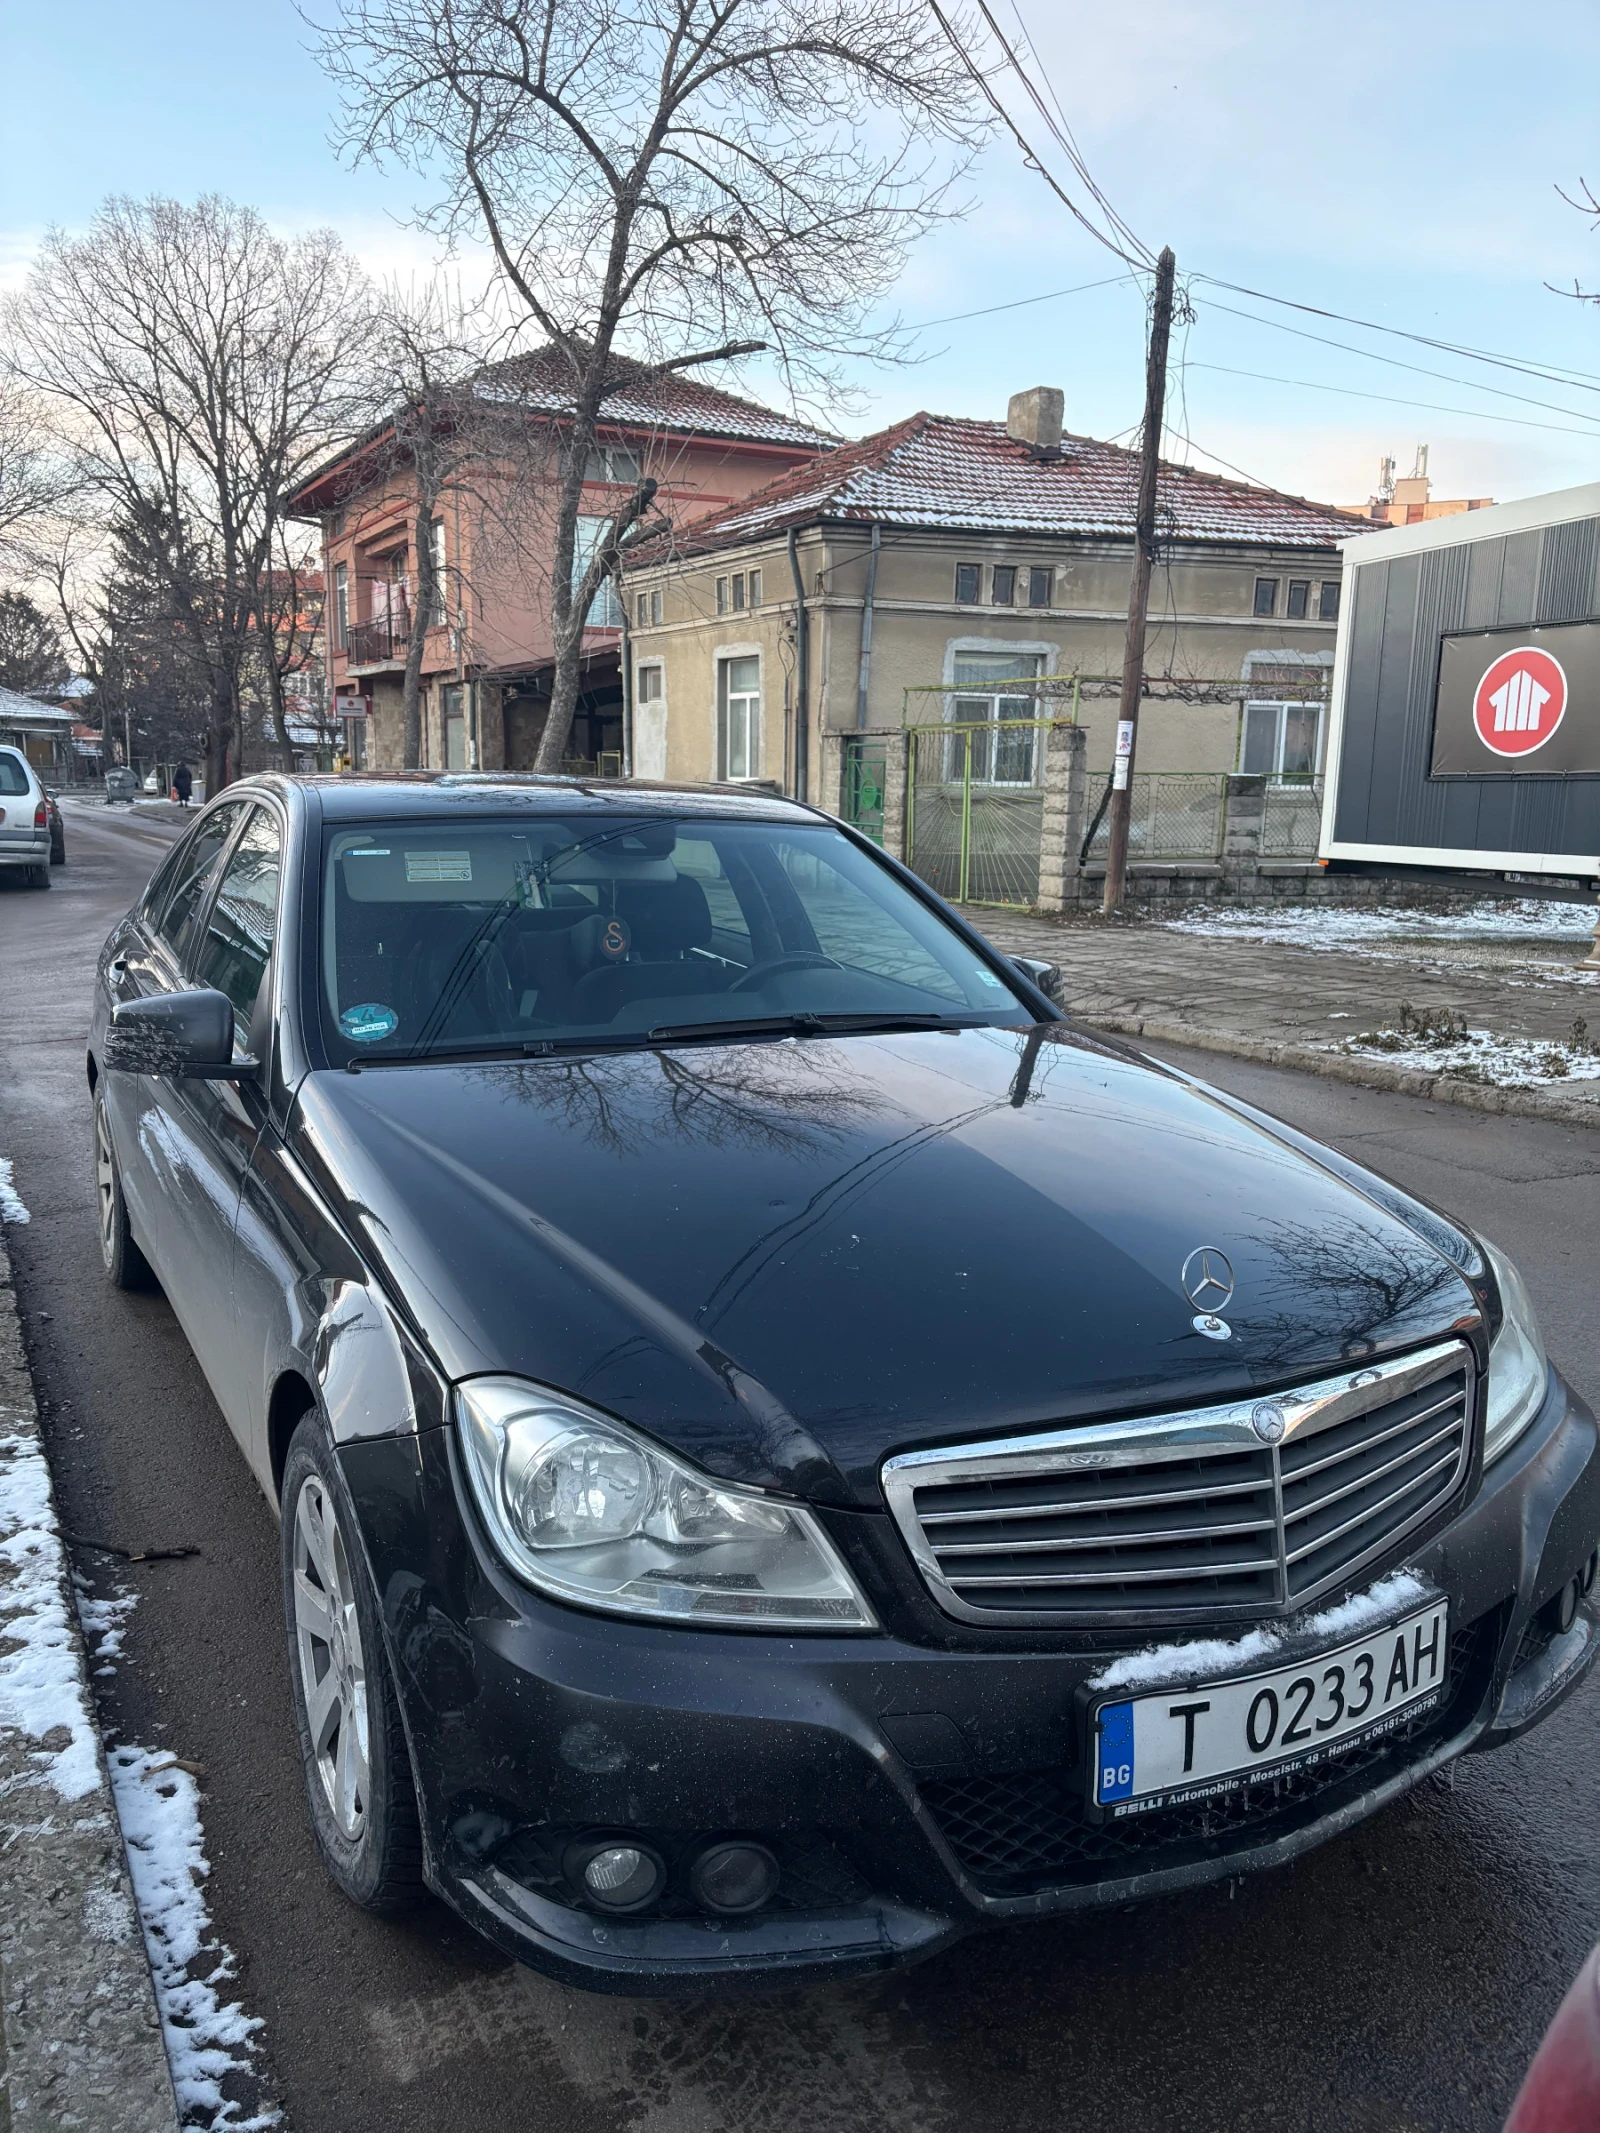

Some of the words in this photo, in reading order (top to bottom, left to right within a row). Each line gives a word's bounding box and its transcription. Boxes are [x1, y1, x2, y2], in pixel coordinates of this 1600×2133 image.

[361, 1008, 375, 1022] 4
[1169, 1700, 1211, 1772] T
[1246, 1653, 1374, 1753] 0233
[1384, 1614, 1439, 1703] AH
[1103, 1764, 1130, 1789] BG
[1114, 1797, 1163, 1817] BELLI
[1167, 1780, 1239, 1805] Automobile
[1250, 1761, 1302, 1784] Moselstr.
[1305, 1752, 1319, 1766] 48
[1328, 1737, 1361, 1757] Hanau
